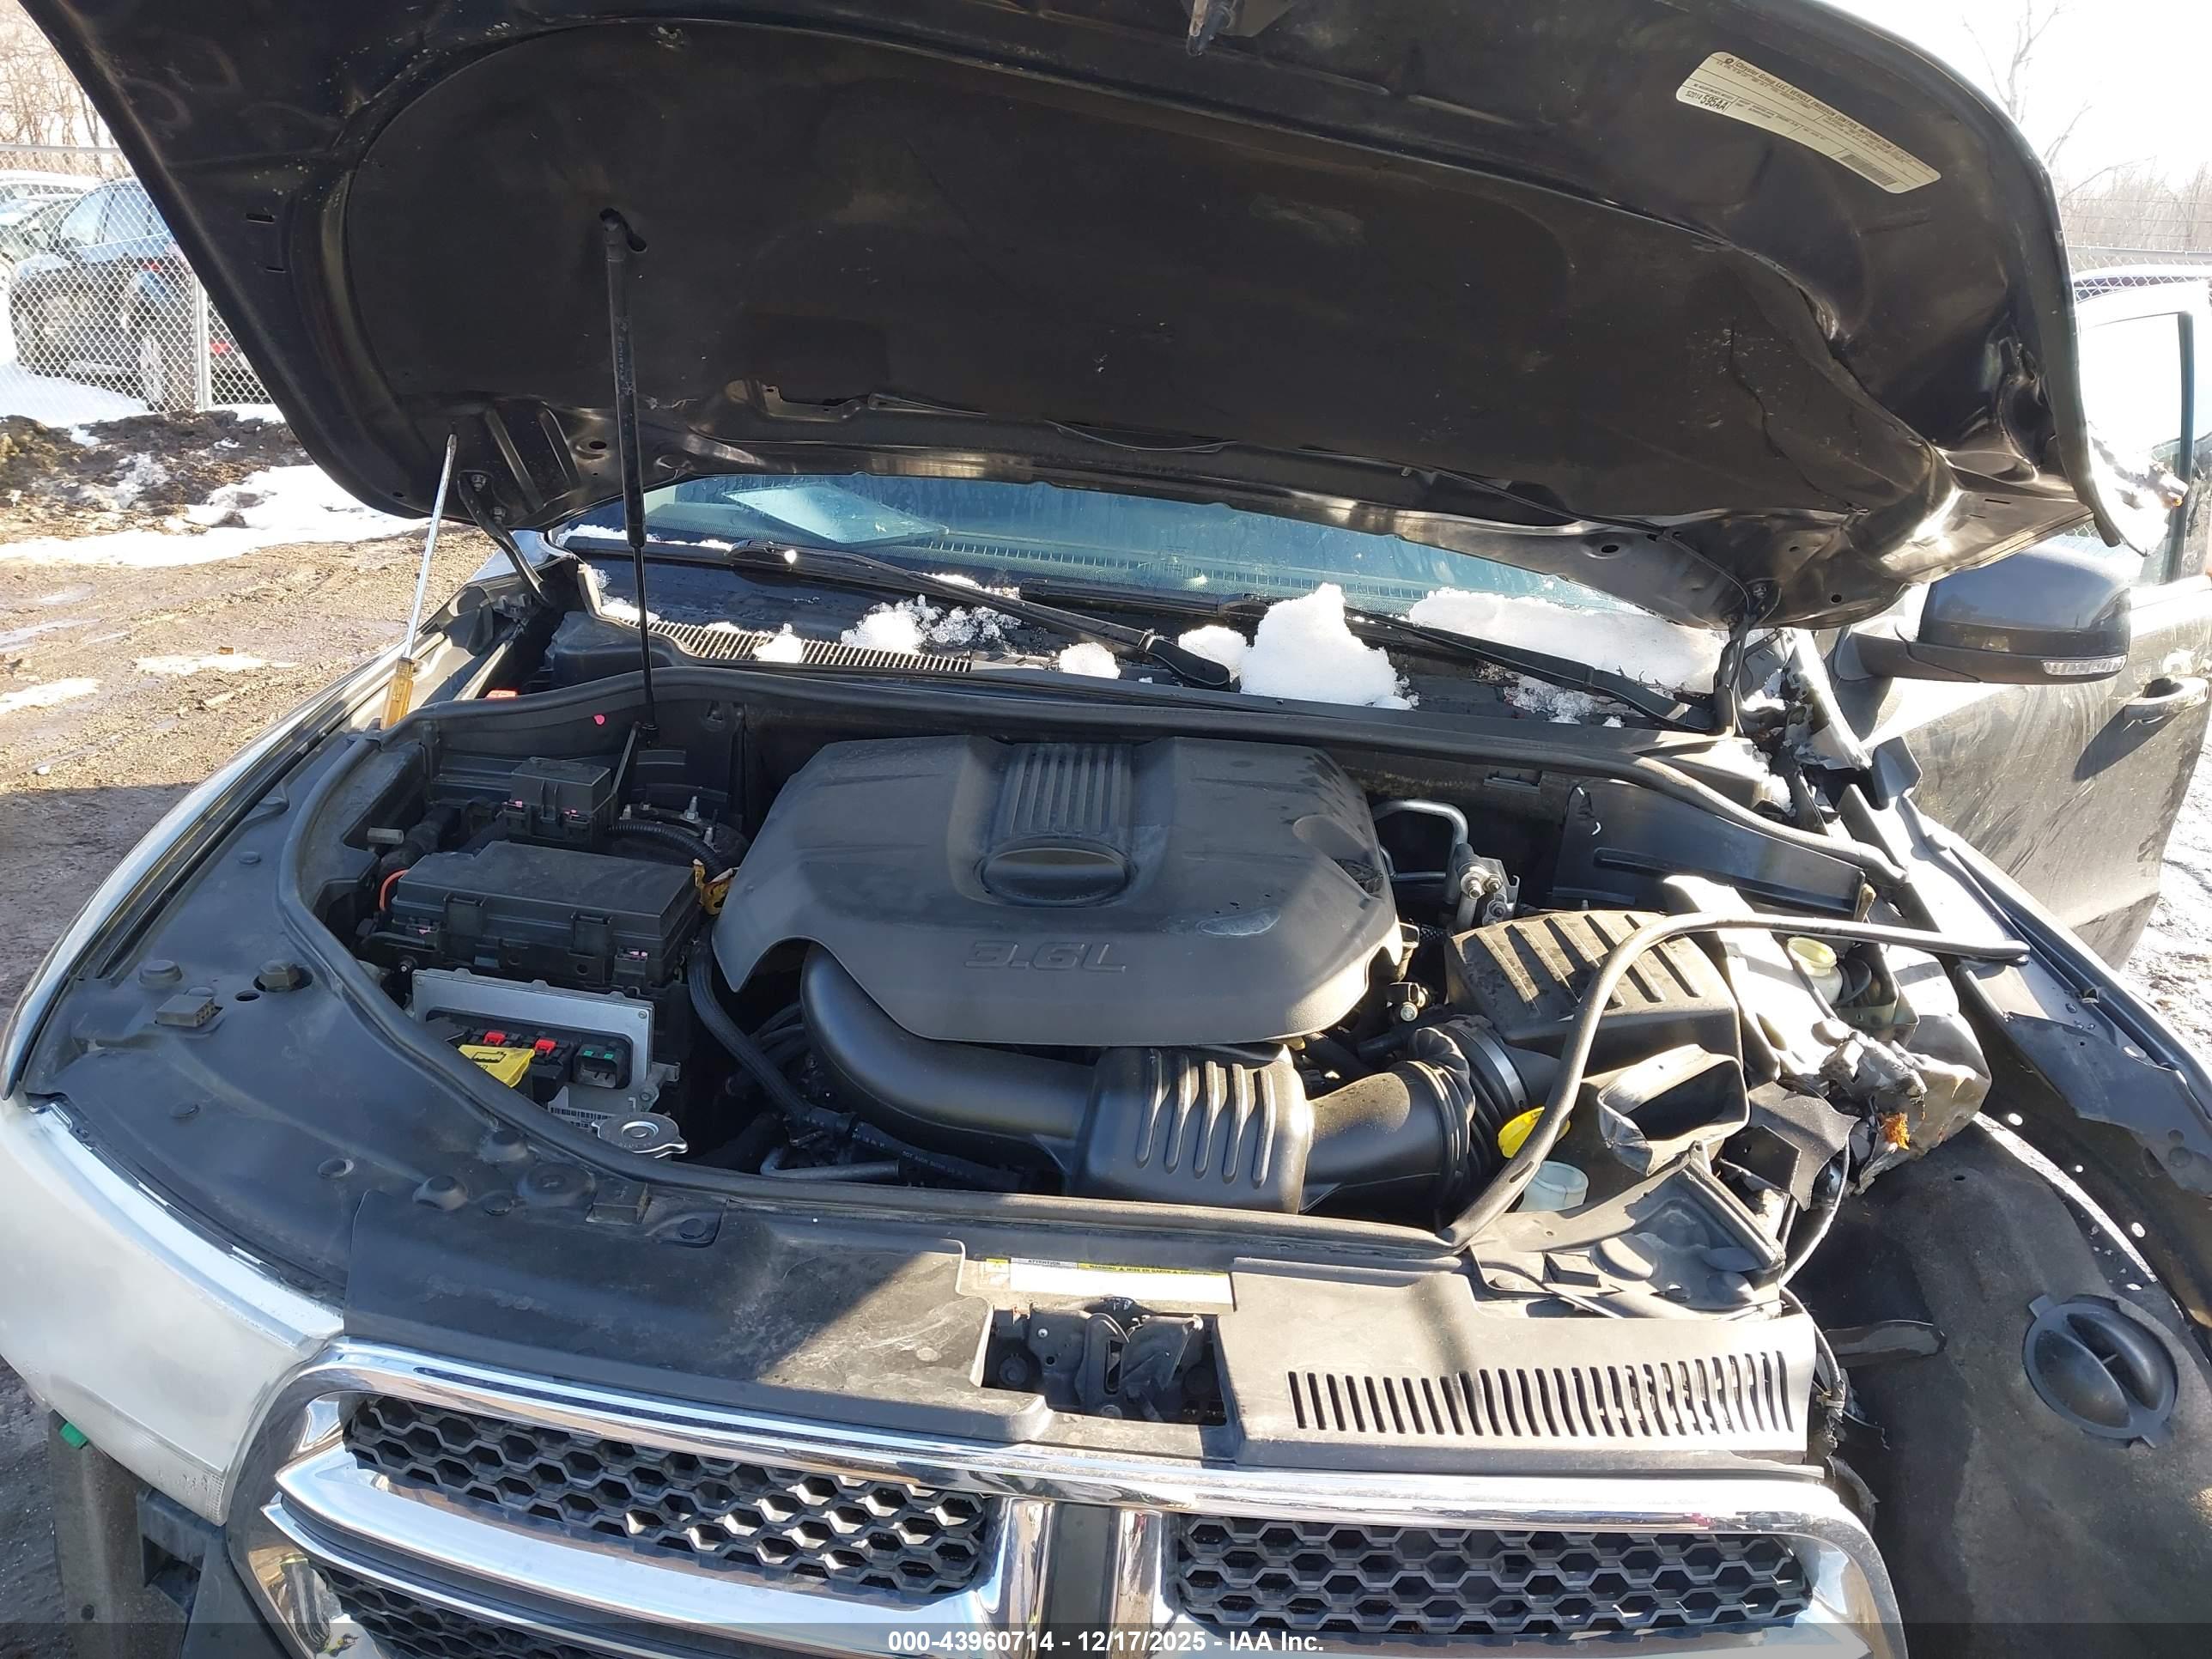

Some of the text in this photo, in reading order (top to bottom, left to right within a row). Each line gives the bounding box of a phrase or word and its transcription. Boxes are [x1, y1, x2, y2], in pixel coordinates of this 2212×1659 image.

[1735, 62, 1759, 76] Chrysler
[1776, 82, 1788, 91] LLC
[963, 939, 1127, 974] 3.6L
